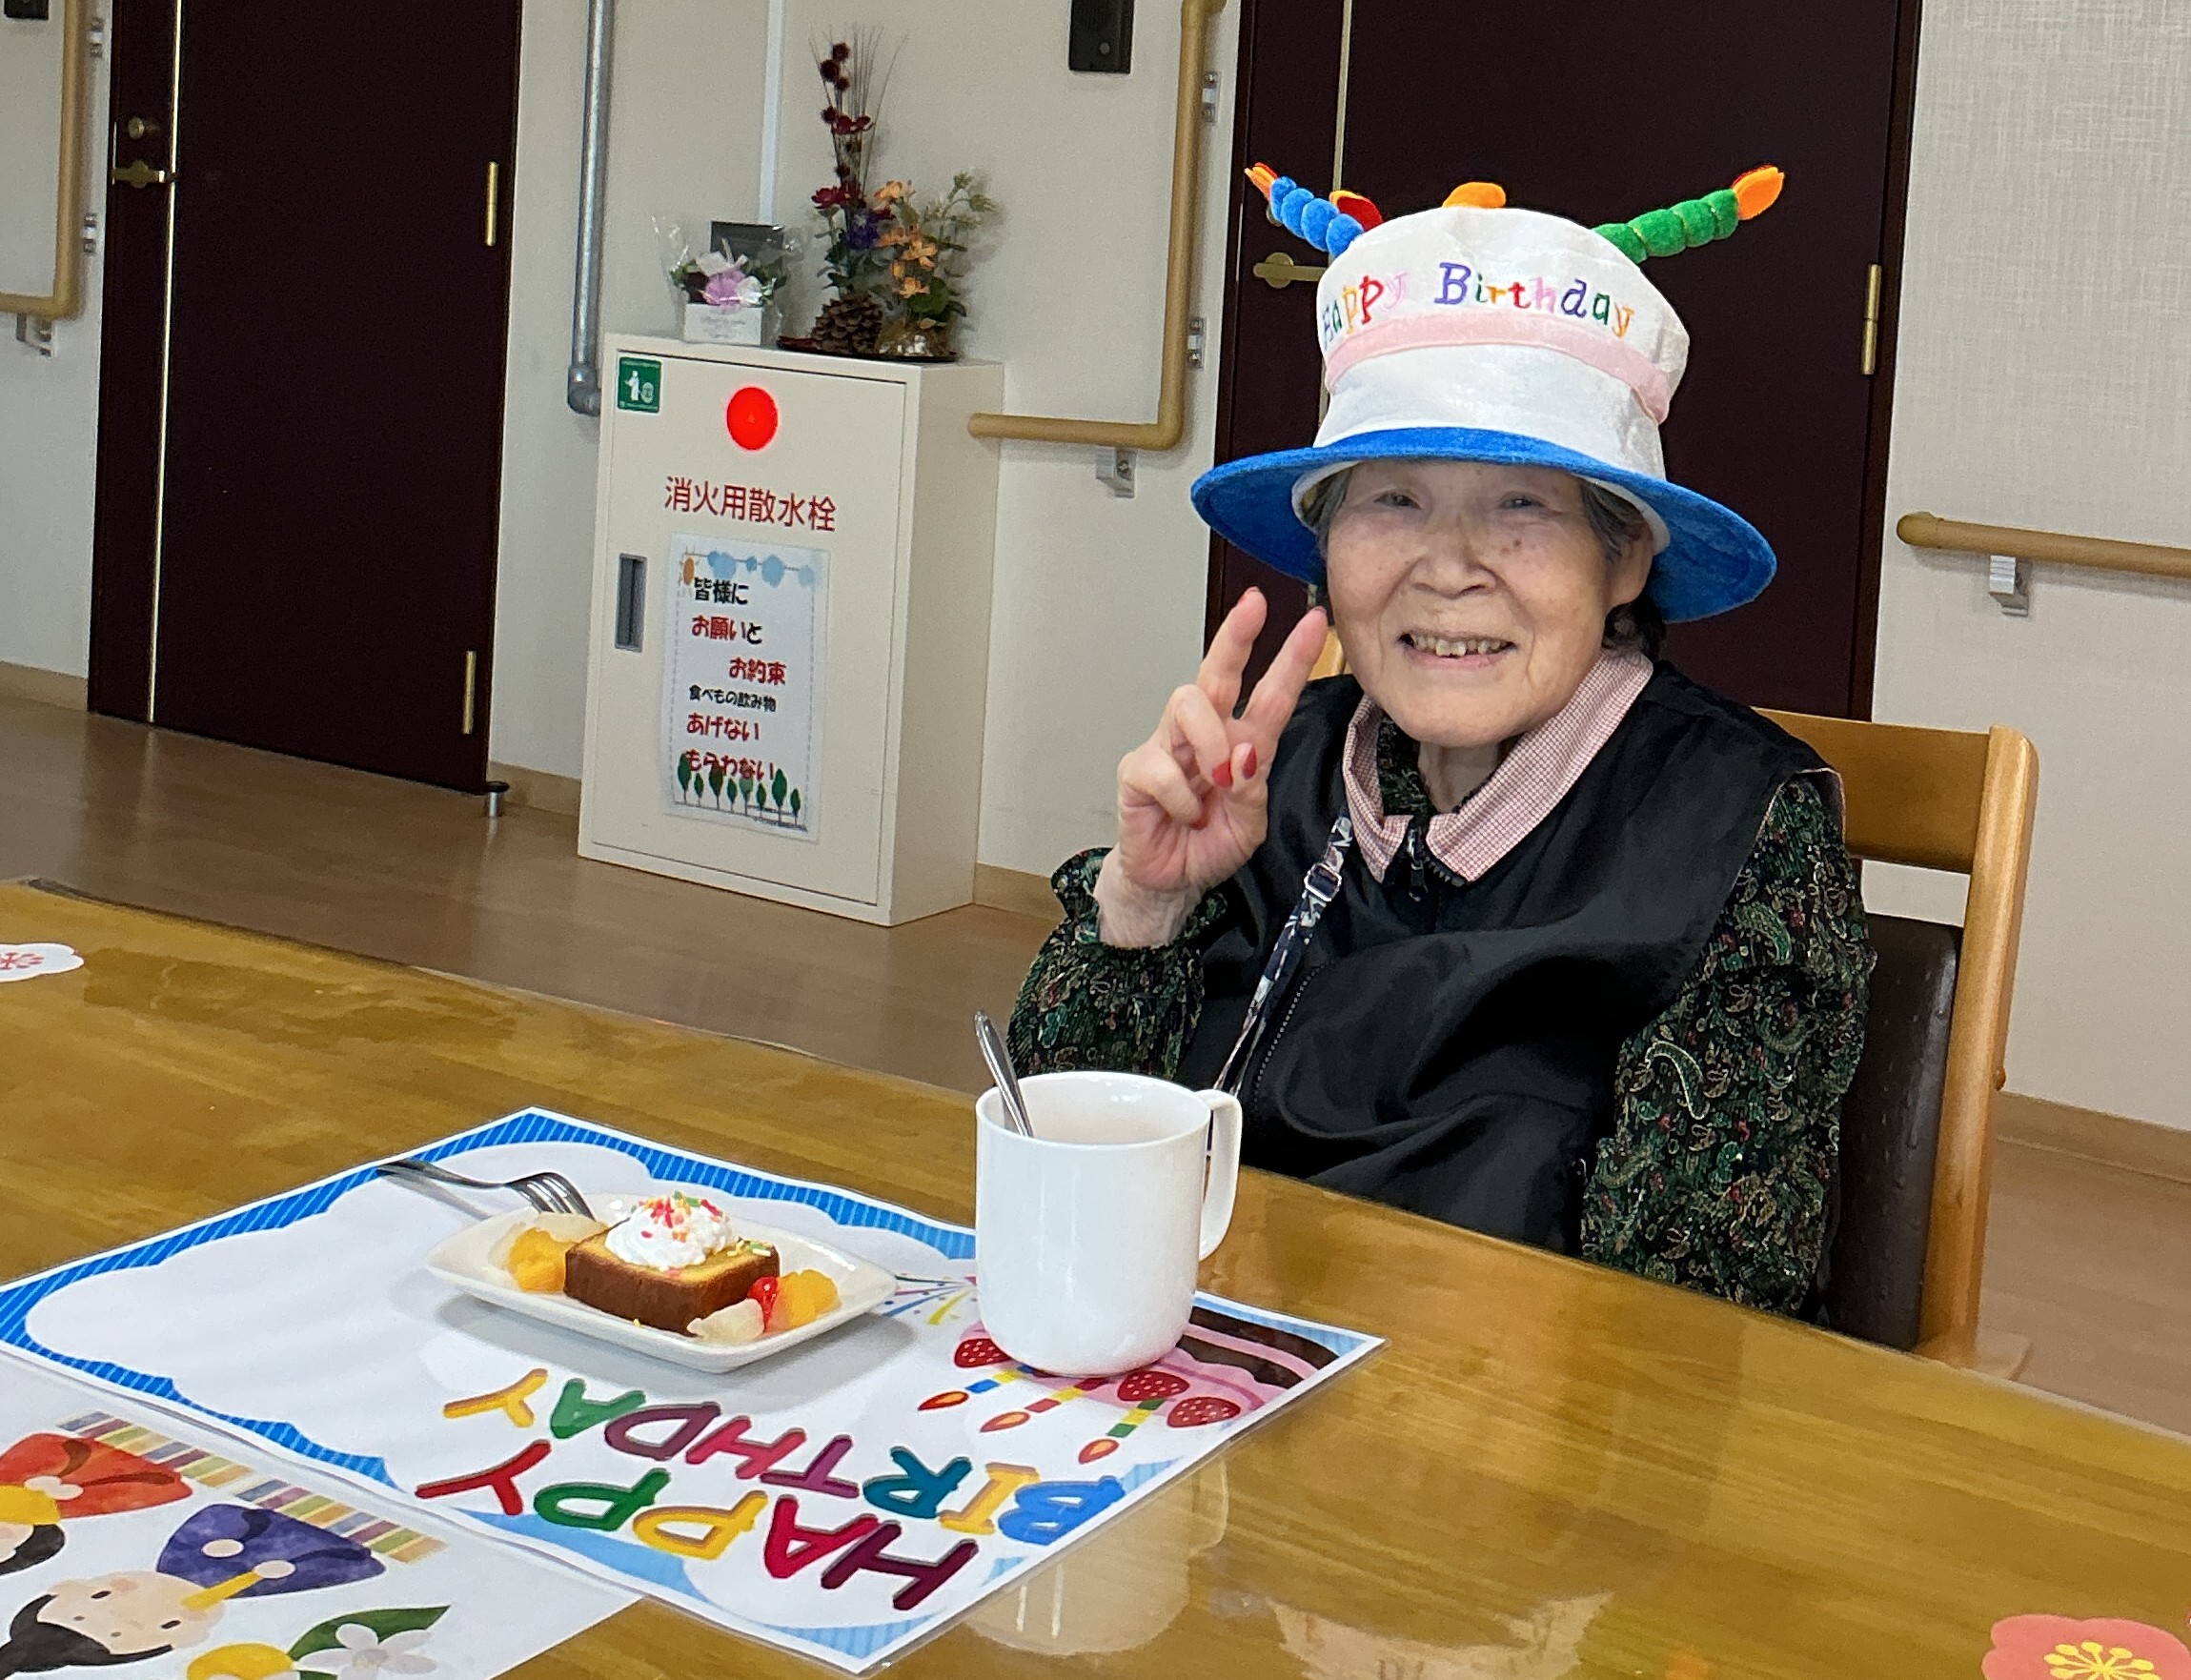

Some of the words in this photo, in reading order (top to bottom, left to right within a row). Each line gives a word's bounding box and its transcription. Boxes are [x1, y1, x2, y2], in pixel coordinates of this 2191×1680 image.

[1322, 270, 1408, 352] Happy
[1434, 262, 1634, 337] Birthday
[664, 476, 836, 532] 消火用散水栓
[694, 577, 749, 605] 皆様に
[692, 615, 763, 644] お願いと
[729, 657, 787, 685] お約束
[686, 712, 761, 741] あげない
[685, 749, 775, 781] もらわない
[443, 1368, 1126, 1545] BIRTHDAY
[415, 1440, 979, 1610] HAPPY
